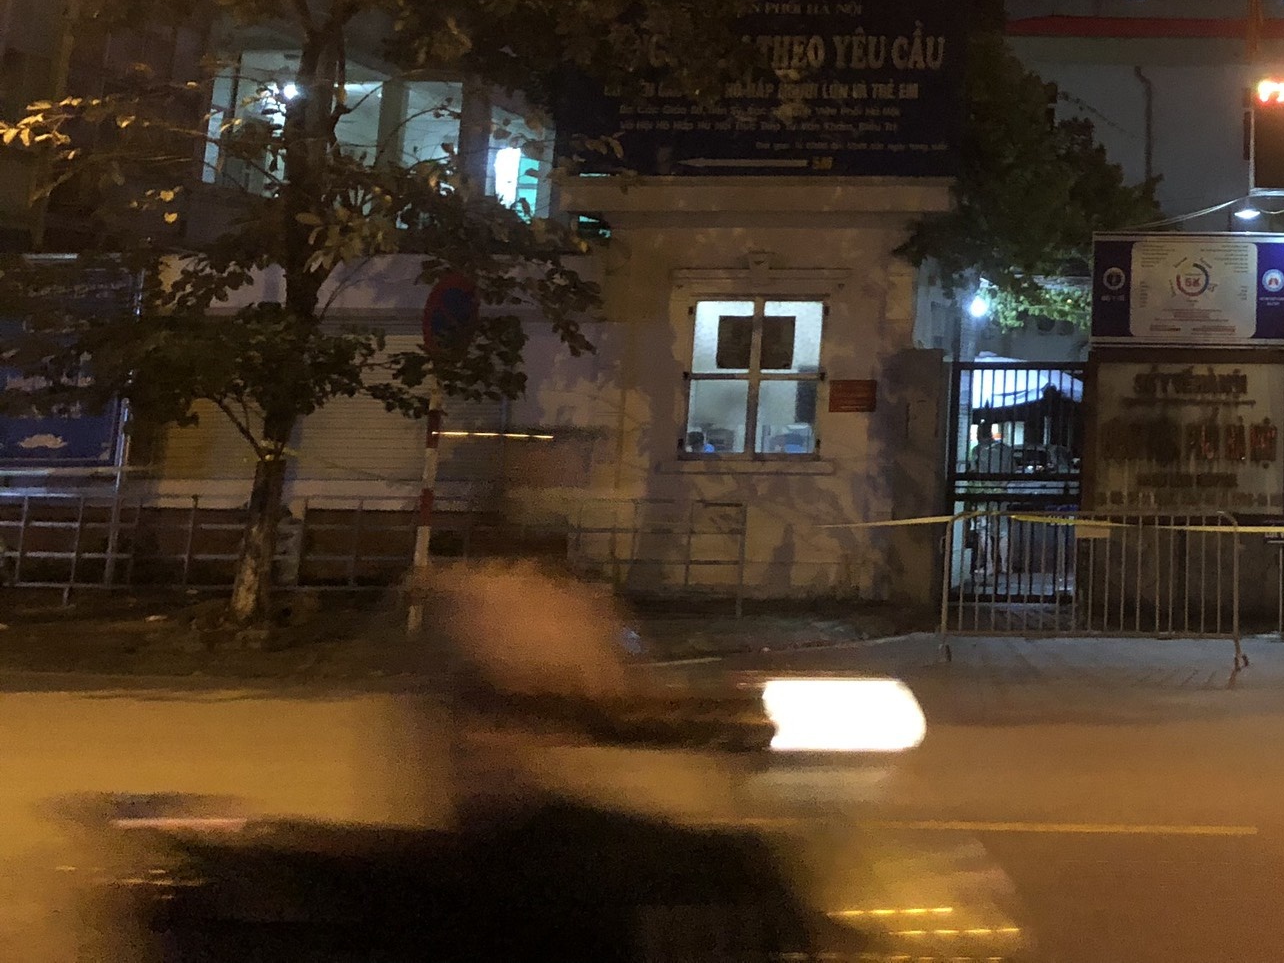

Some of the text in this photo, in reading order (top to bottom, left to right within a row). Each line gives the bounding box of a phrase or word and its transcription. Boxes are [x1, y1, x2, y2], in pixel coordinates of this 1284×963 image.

[757, 19, 946, 70] THEO YÊU CẦU
